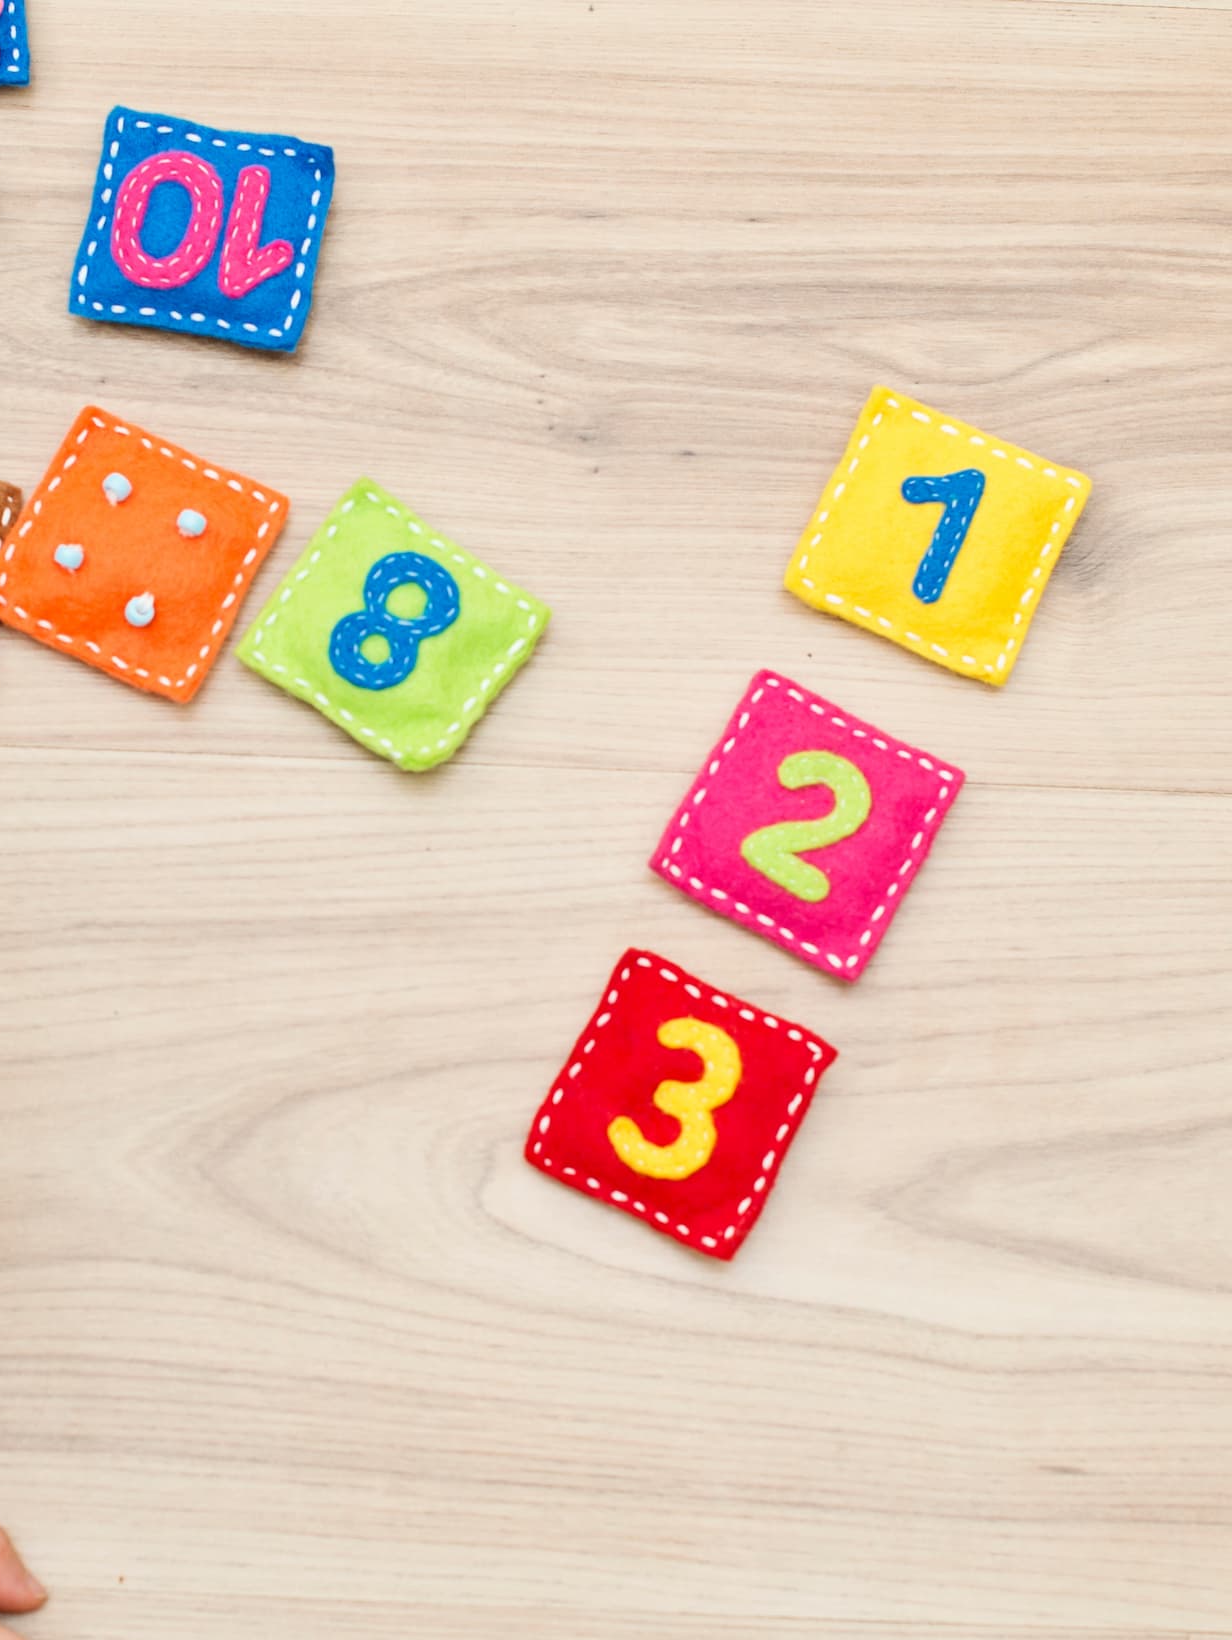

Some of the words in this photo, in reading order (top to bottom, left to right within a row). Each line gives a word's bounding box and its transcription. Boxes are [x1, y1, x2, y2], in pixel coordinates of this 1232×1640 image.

[110, 151, 294, 299] 10
[900, 468, 985, 605] 1
[328, 551, 460, 690] 8
[740, 749, 872, 903] 2
[606, 1015, 742, 1180] 3
